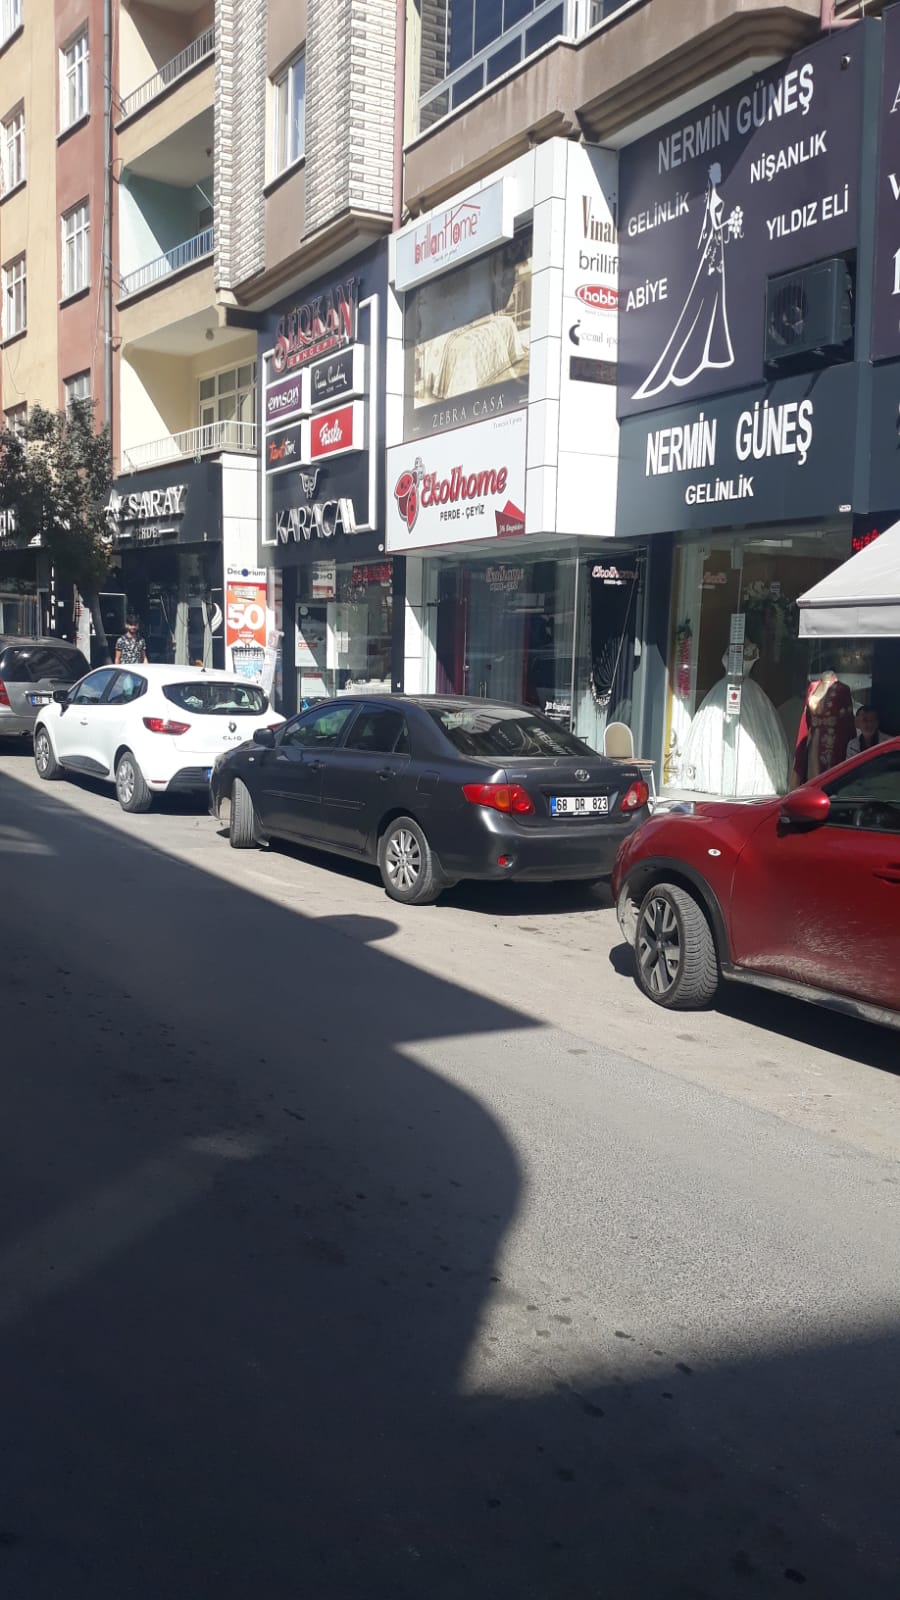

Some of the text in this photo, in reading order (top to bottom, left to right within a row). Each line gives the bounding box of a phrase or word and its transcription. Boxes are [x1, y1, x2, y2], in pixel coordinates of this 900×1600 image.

[657, 104, 730, 175] NERMİN
[736, 62, 814, 134] GÜNEŞ
[750, 129, 828, 184] NİŞANLIK
[627, 191, 690, 237] GELİNLİK
[766, 201, 817, 241] YILDIZ
[822, 184, 849, 222] ELİ
[584, 286, 618, 306] hobb
[625, 277, 669, 312] ABİYE
[432, 394, 505, 427] ZEBRA CASA
[645, 399, 814, 477] NERMİN GÜNEŞ
[420, 463, 509, 508] Ekolhome
[685, 473, 754, 505] GELİNLİK
[275, 497, 357, 544] KARACA
[440, 508, 461, 521] PERDE
[465, 503, 485, 519] ÇEYİZ
[227, 603, 266, 630] 50
[557, 798, 568, 811] 68
[592, 797, 608, 810] 823
